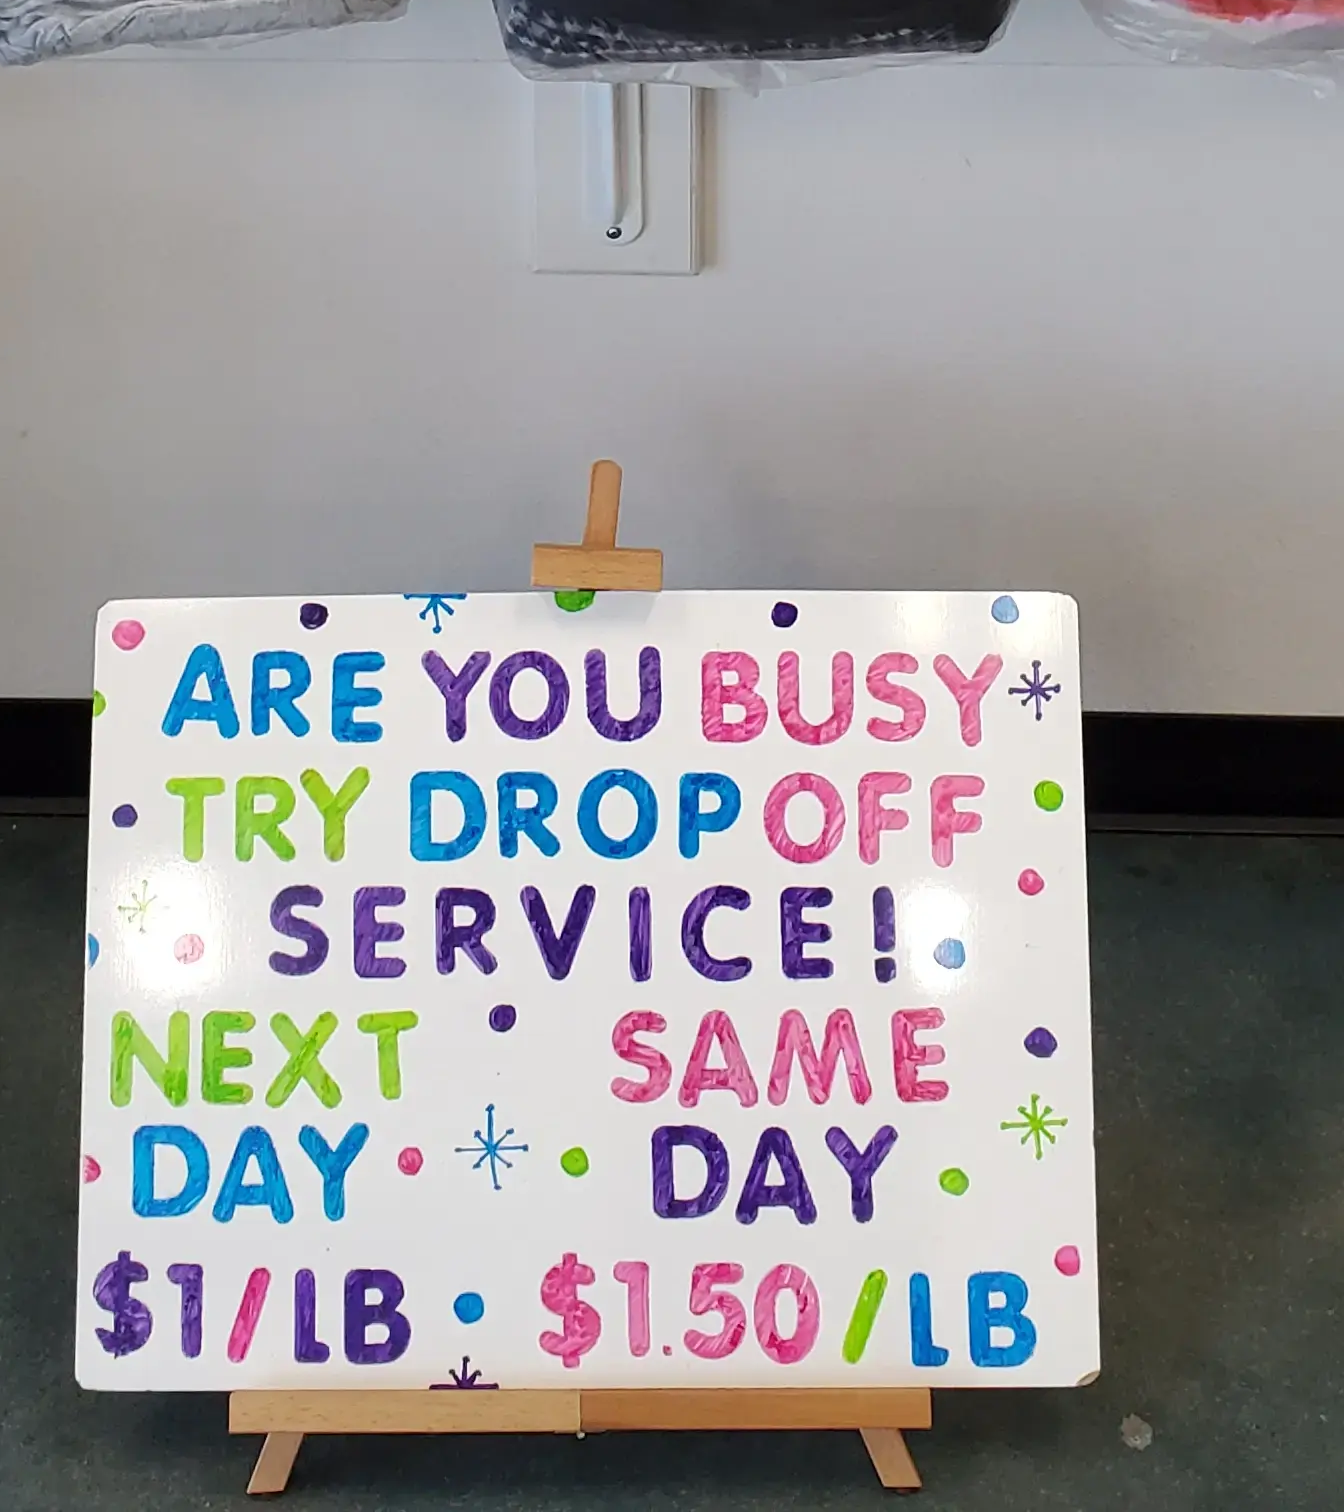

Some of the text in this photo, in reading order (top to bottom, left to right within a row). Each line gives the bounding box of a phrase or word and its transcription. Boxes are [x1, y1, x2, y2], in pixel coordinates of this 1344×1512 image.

[160, 643, 1004, 747] ARE YOU BUSY
[164, 765, 986, 868] TRY DROP OFF
[267, 884, 896, 983] SERVICE!
[108, 1009, 420, 1109] NEXT
[609, 1007, 951, 1109] SAME
[131, 1122, 371, 1226] DAY
[650, 1124, 899, 1225] DAY
[92, 1250, 412, 1365] $1/LB
[537, 1251, 1039, 1370] $1.50/LB
